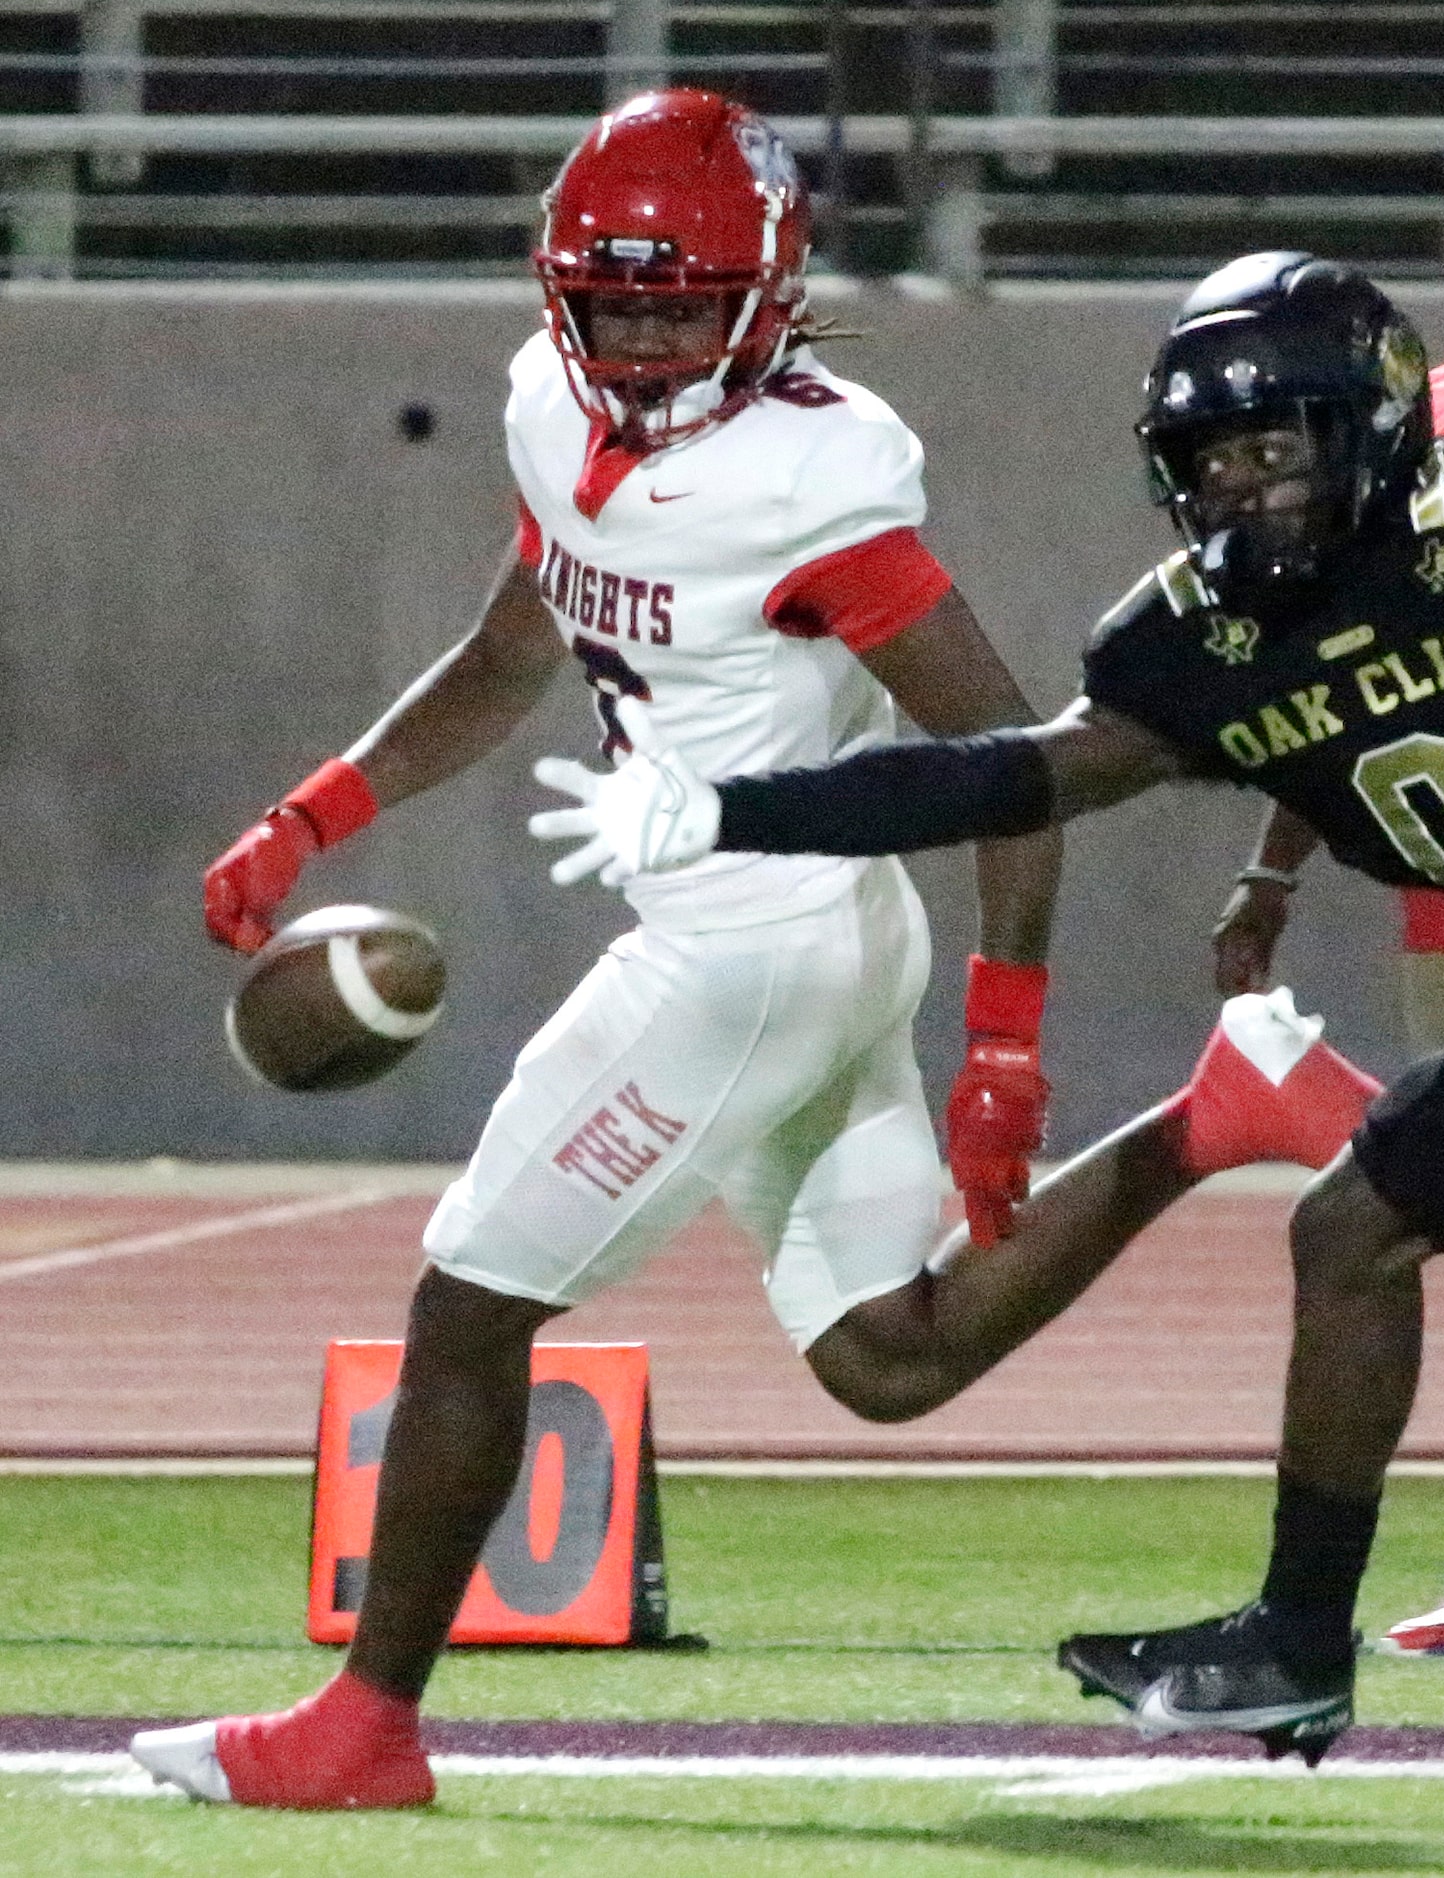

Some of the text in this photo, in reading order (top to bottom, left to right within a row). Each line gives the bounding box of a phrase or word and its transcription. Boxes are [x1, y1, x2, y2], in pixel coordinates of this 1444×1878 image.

[1218, 685, 1344, 767] OAK
[552, 1080, 687, 1200] THE K
